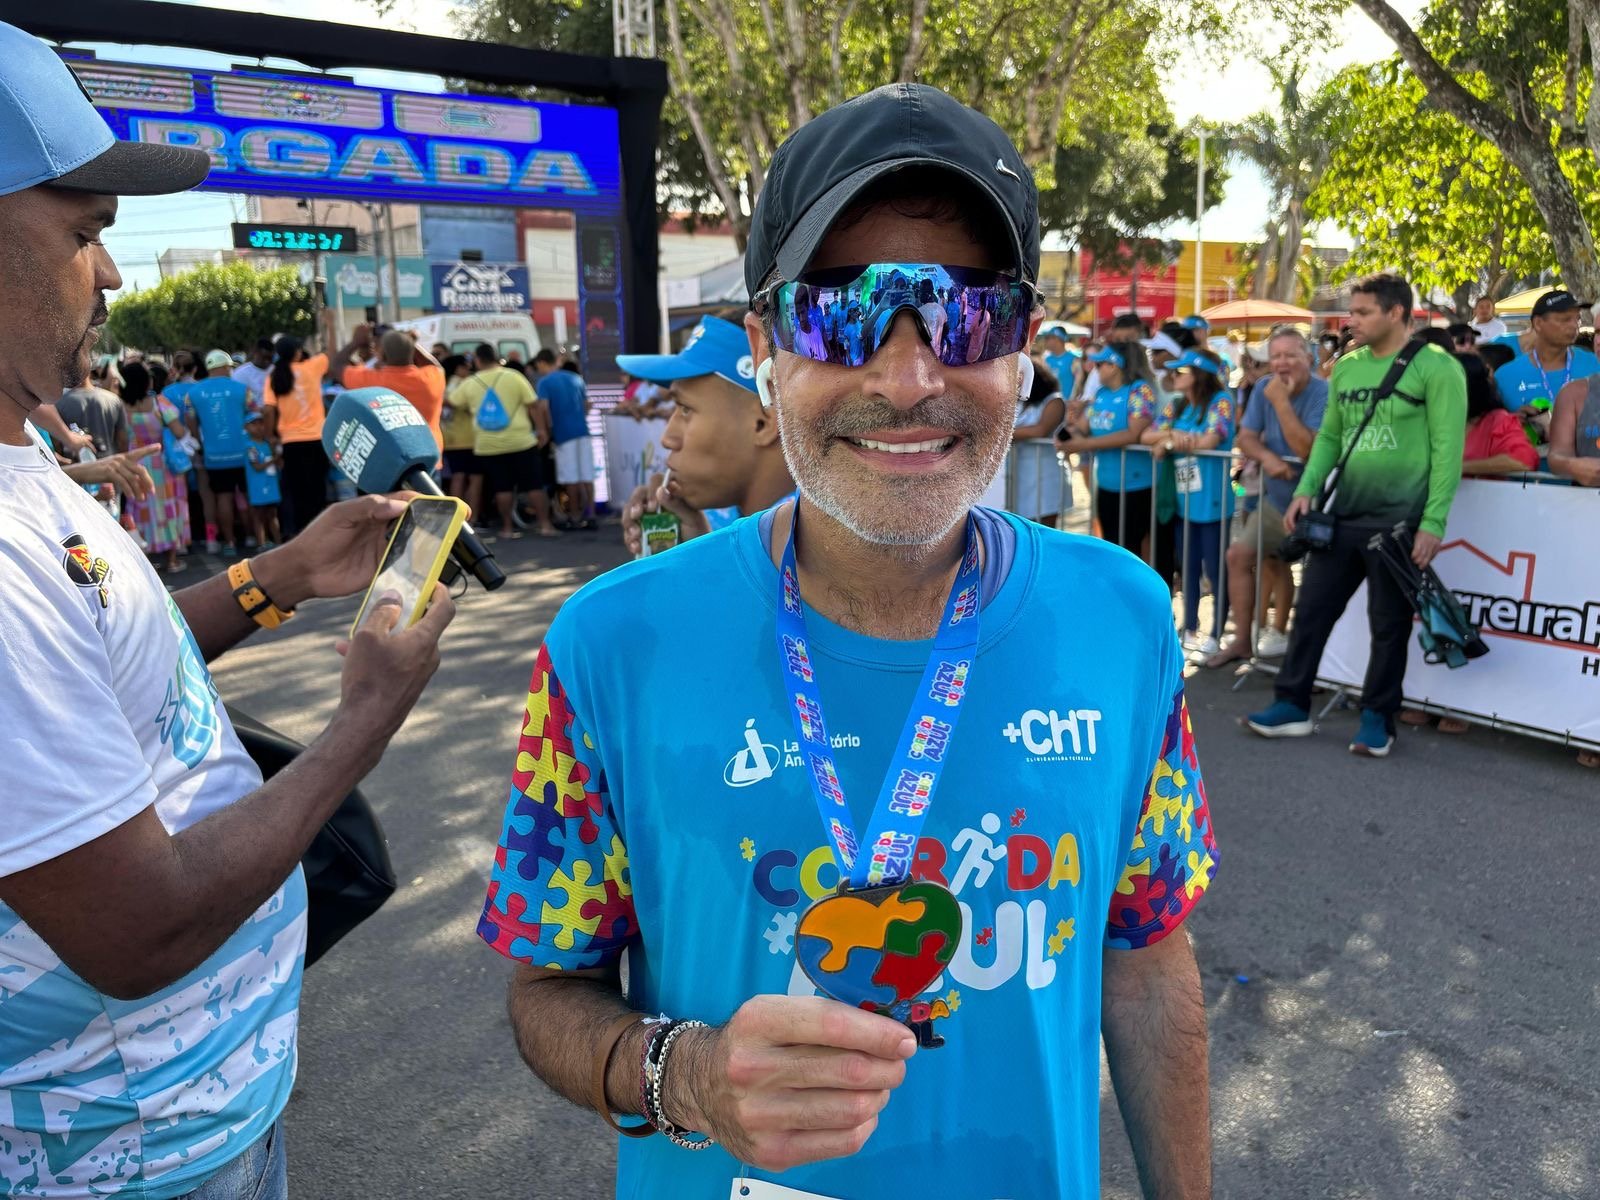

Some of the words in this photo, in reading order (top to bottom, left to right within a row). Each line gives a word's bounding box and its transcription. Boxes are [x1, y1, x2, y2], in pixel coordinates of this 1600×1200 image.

[130, 118, 598, 195] RGADA
[1451, 589, 1600, 646] rreira
[929, 661, 957, 701] AZUL
[1581, 655, 1600, 676] H
[924, 722, 952, 762] AZUL
[889, 769, 920, 813] AZUL
